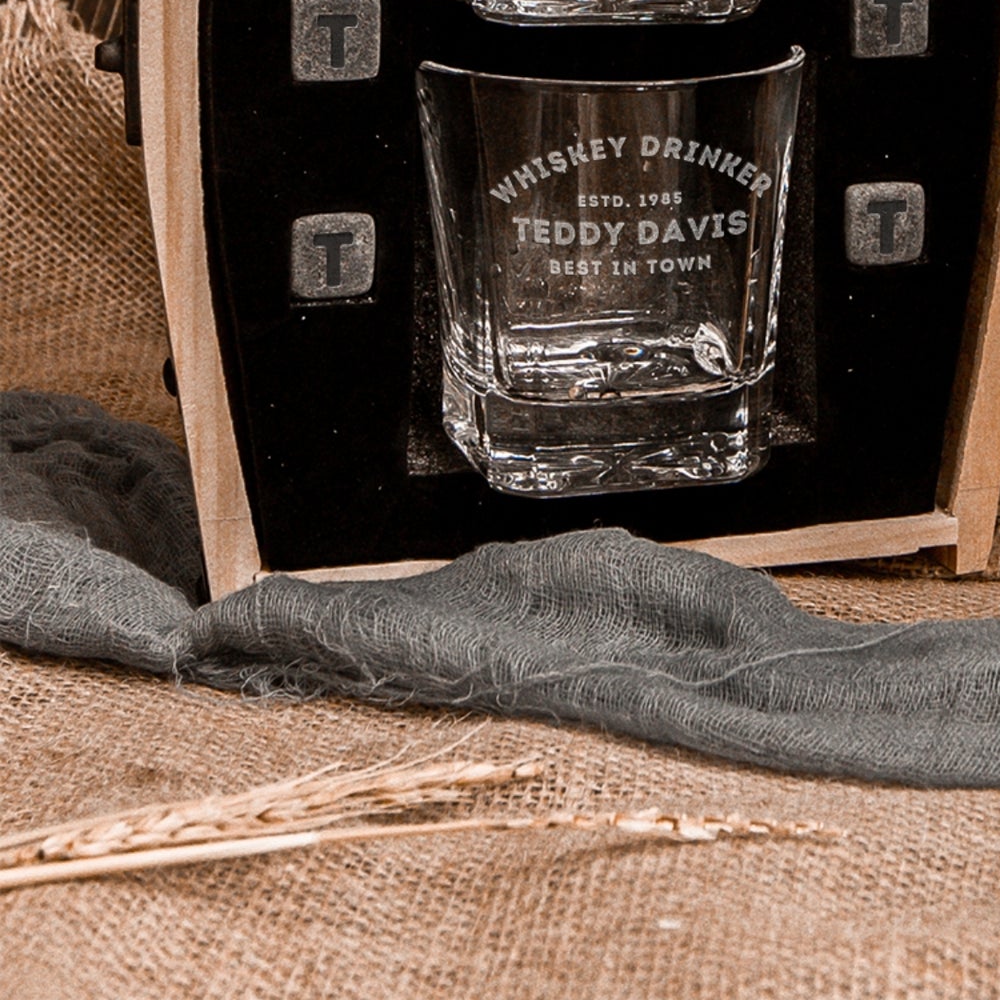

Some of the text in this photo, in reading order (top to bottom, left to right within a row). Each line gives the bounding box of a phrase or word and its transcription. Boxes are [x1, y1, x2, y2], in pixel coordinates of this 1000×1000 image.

[317, 14, 358, 68] T
[490, 135, 772, 204] WHISKEY DRINKER
[577, 192, 682, 208] ESTD. 1985
[867, 199, 907, 255] T
[512, 210, 748, 246] TEDDY DAVIS
[313, 232, 354, 288] T
[550, 255, 712, 275] BEST IN TOWN
